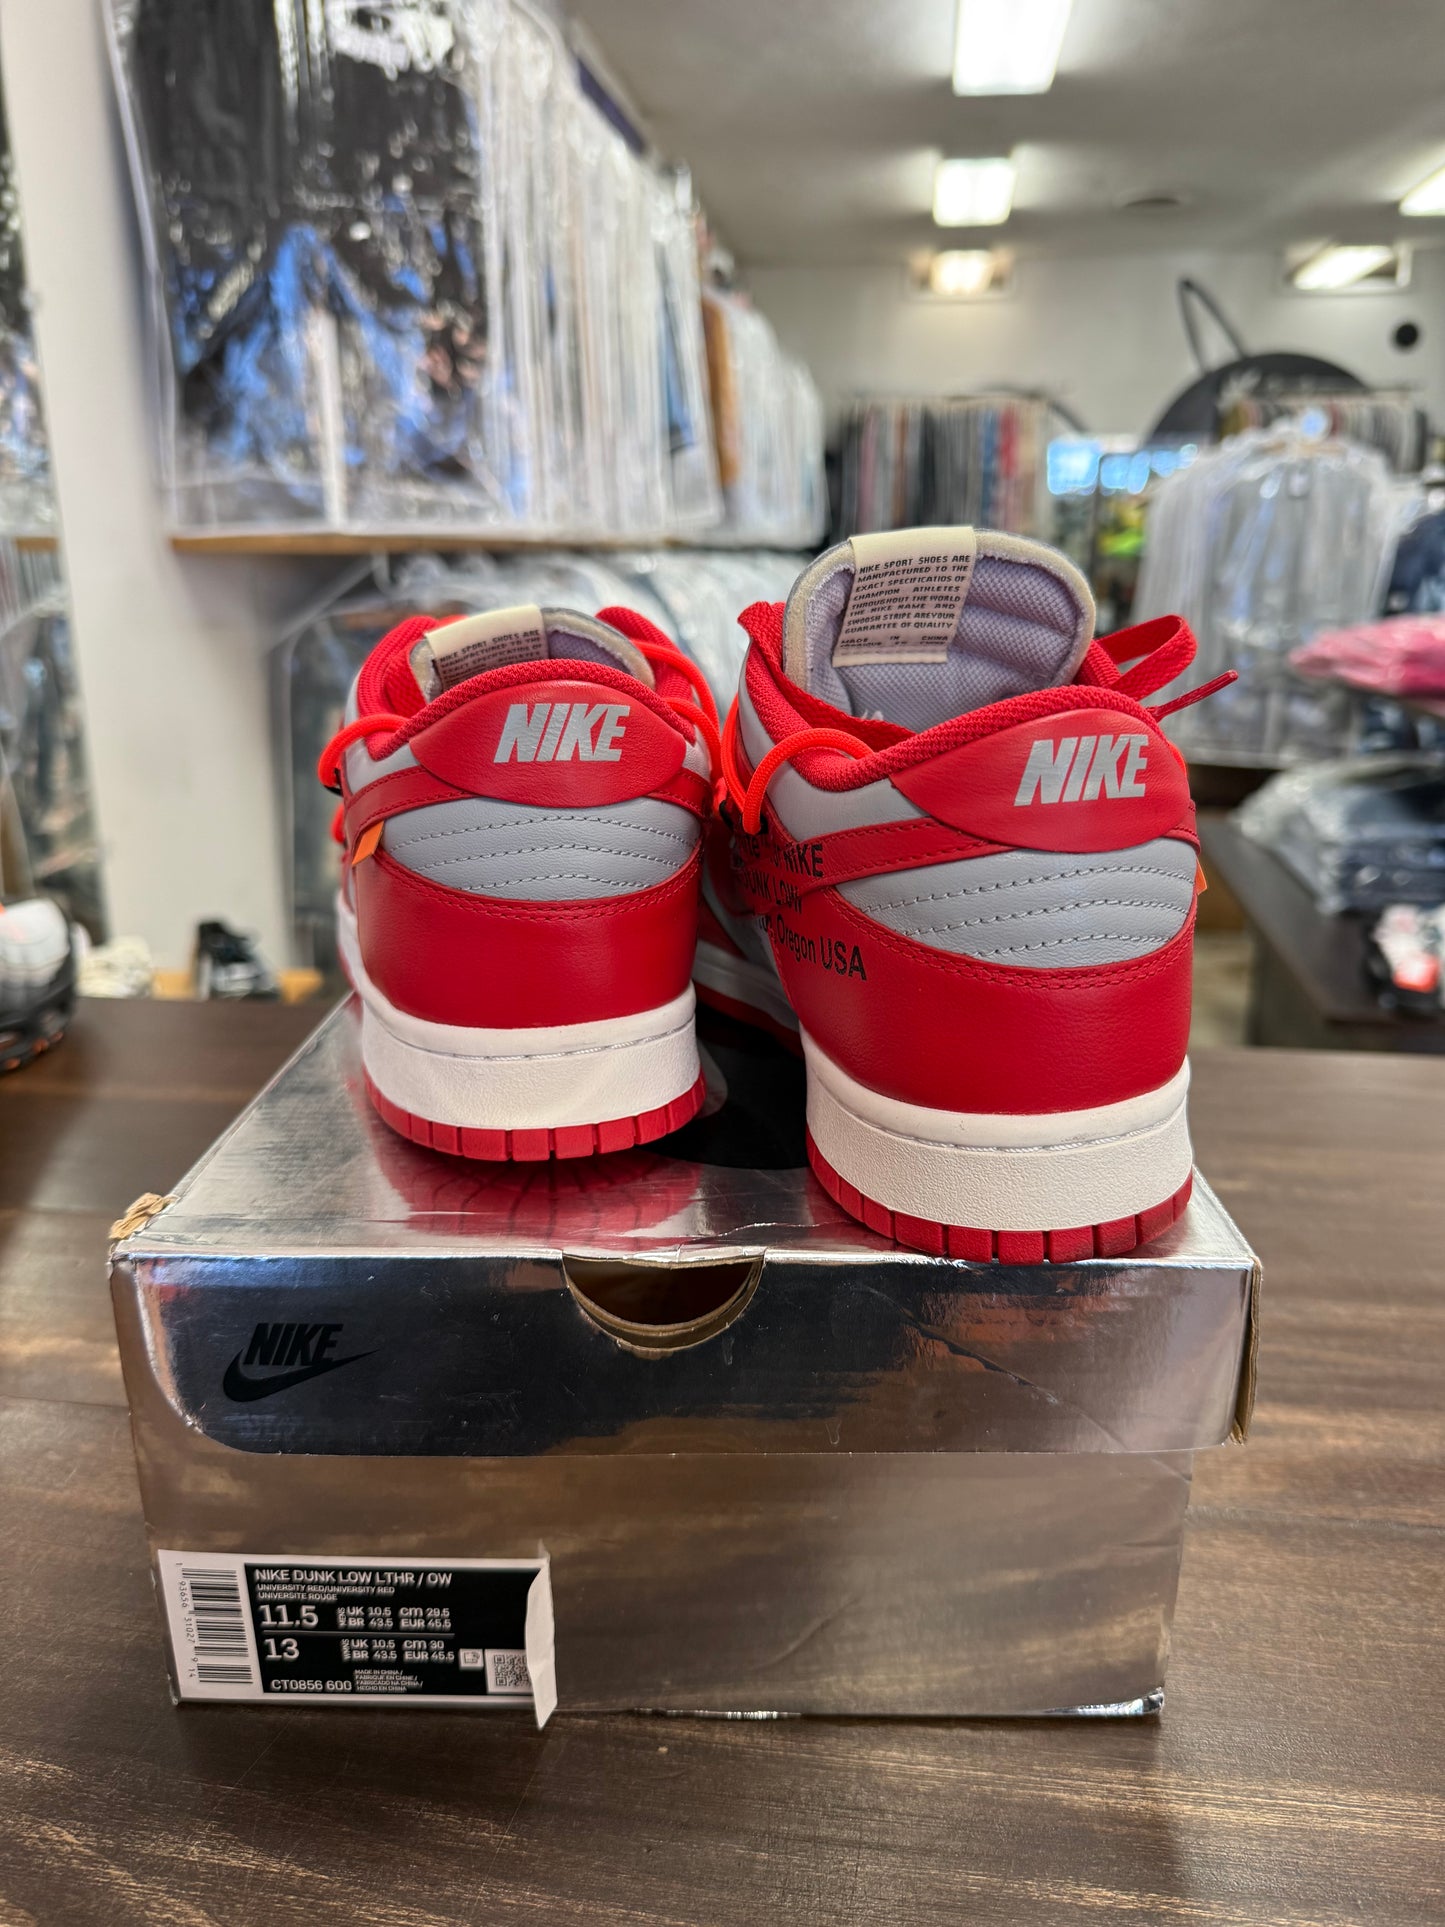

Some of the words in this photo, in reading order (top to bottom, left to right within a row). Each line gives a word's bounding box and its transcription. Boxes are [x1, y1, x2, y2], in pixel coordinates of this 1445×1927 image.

[859, 564, 881, 574] NIKE
[884, 559, 913, 570] SPORT
[918, 555, 948, 564] SHOES
[952, 555, 971, 563] ARE
[857, 566, 931, 583] MANUFACTURED
[853, 588, 900, 601] CHAMPION
[855, 582, 884, 593] EXACT
[851, 596, 909, 610] THROUGHOUT
[847, 615, 881, 627] SWOOSH
[882, 612, 911, 620] STRIPE
[844, 622, 897, 634] GUARANTEE
[461, 641, 487, 655] SPORT
[491, 633, 519, 643] SHOES
[494, 703, 631, 763] NIKE
[1014, 734, 1149, 807] NIKE
[784, 843, 823, 878] NIKE
[776, 914, 817, 963] Oregon
[820, 935, 867, 981] USA
[243, 1323, 344, 1366] NIKE
[255, 1569, 291, 1581] NIKE
[293, 1570, 336, 1582] DUNK
[338, 1571, 373, 1583] LOW
[376, 1572, 415, 1584] LTHR
[426, 1572, 453, 1585] OW
[256, 1583, 306, 1591] UNIVERSITY
[306, 1585, 376, 1594] RED/UNIVERSITY
[376, 1586, 395, 1594] RED
[257, 1592, 307, 1600] UNIVERSITE
[308, 1593, 338, 1601] ROUGE
[179, 1580, 189, 1608] 93656
[184, 1617, 196, 1643] 31027
[259, 1604, 319, 1627] 11.5
[346, 1606, 365, 1616] UK
[367, 1607, 392, 1617] 10.5
[400, 1607, 424, 1617] cm
[425, 1607, 450, 1617] 29.5
[348, 1617, 365, 1626] BR
[369, 1618, 393, 1627] 43.5
[401, 1619, 425, 1628] EUR
[426, 1619, 452, 1628] 45.5
[265, 1638, 300, 1660] 13
[351, 1639, 369, 1648] UK
[371, 1639, 396, 1649] 10.5
[403, 1640, 427, 1649] cm
[429, 1640, 445, 1649] 30
[352, 1650, 369, 1659] BR
[372, 1650, 397, 1660] 43.5
[404, 1651, 429, 1660] EUR
[430, 1651, 455, 1661] 45.5
[271, 1679, 323, 1691] CT0856
[326, 1679, 352, 1691] 600
